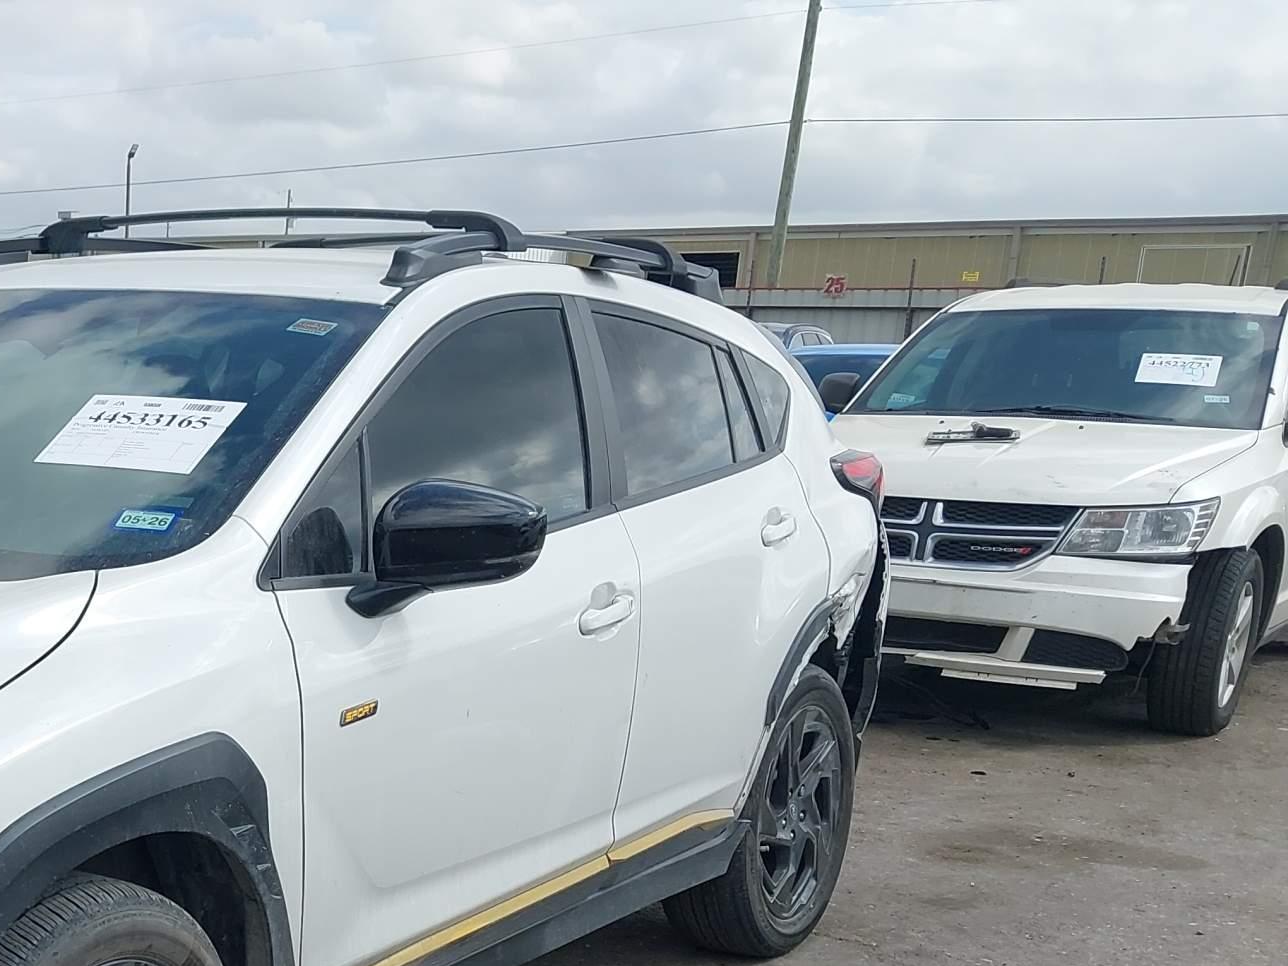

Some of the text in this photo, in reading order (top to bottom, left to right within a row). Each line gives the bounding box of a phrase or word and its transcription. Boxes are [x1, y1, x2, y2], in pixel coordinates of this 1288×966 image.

[823, 275, 846, 294] 25
[88, 410, 212, 430] 44533165
[970, 545, 1022, 553] DODGE
[344, 702, 377, 723] SPORT
